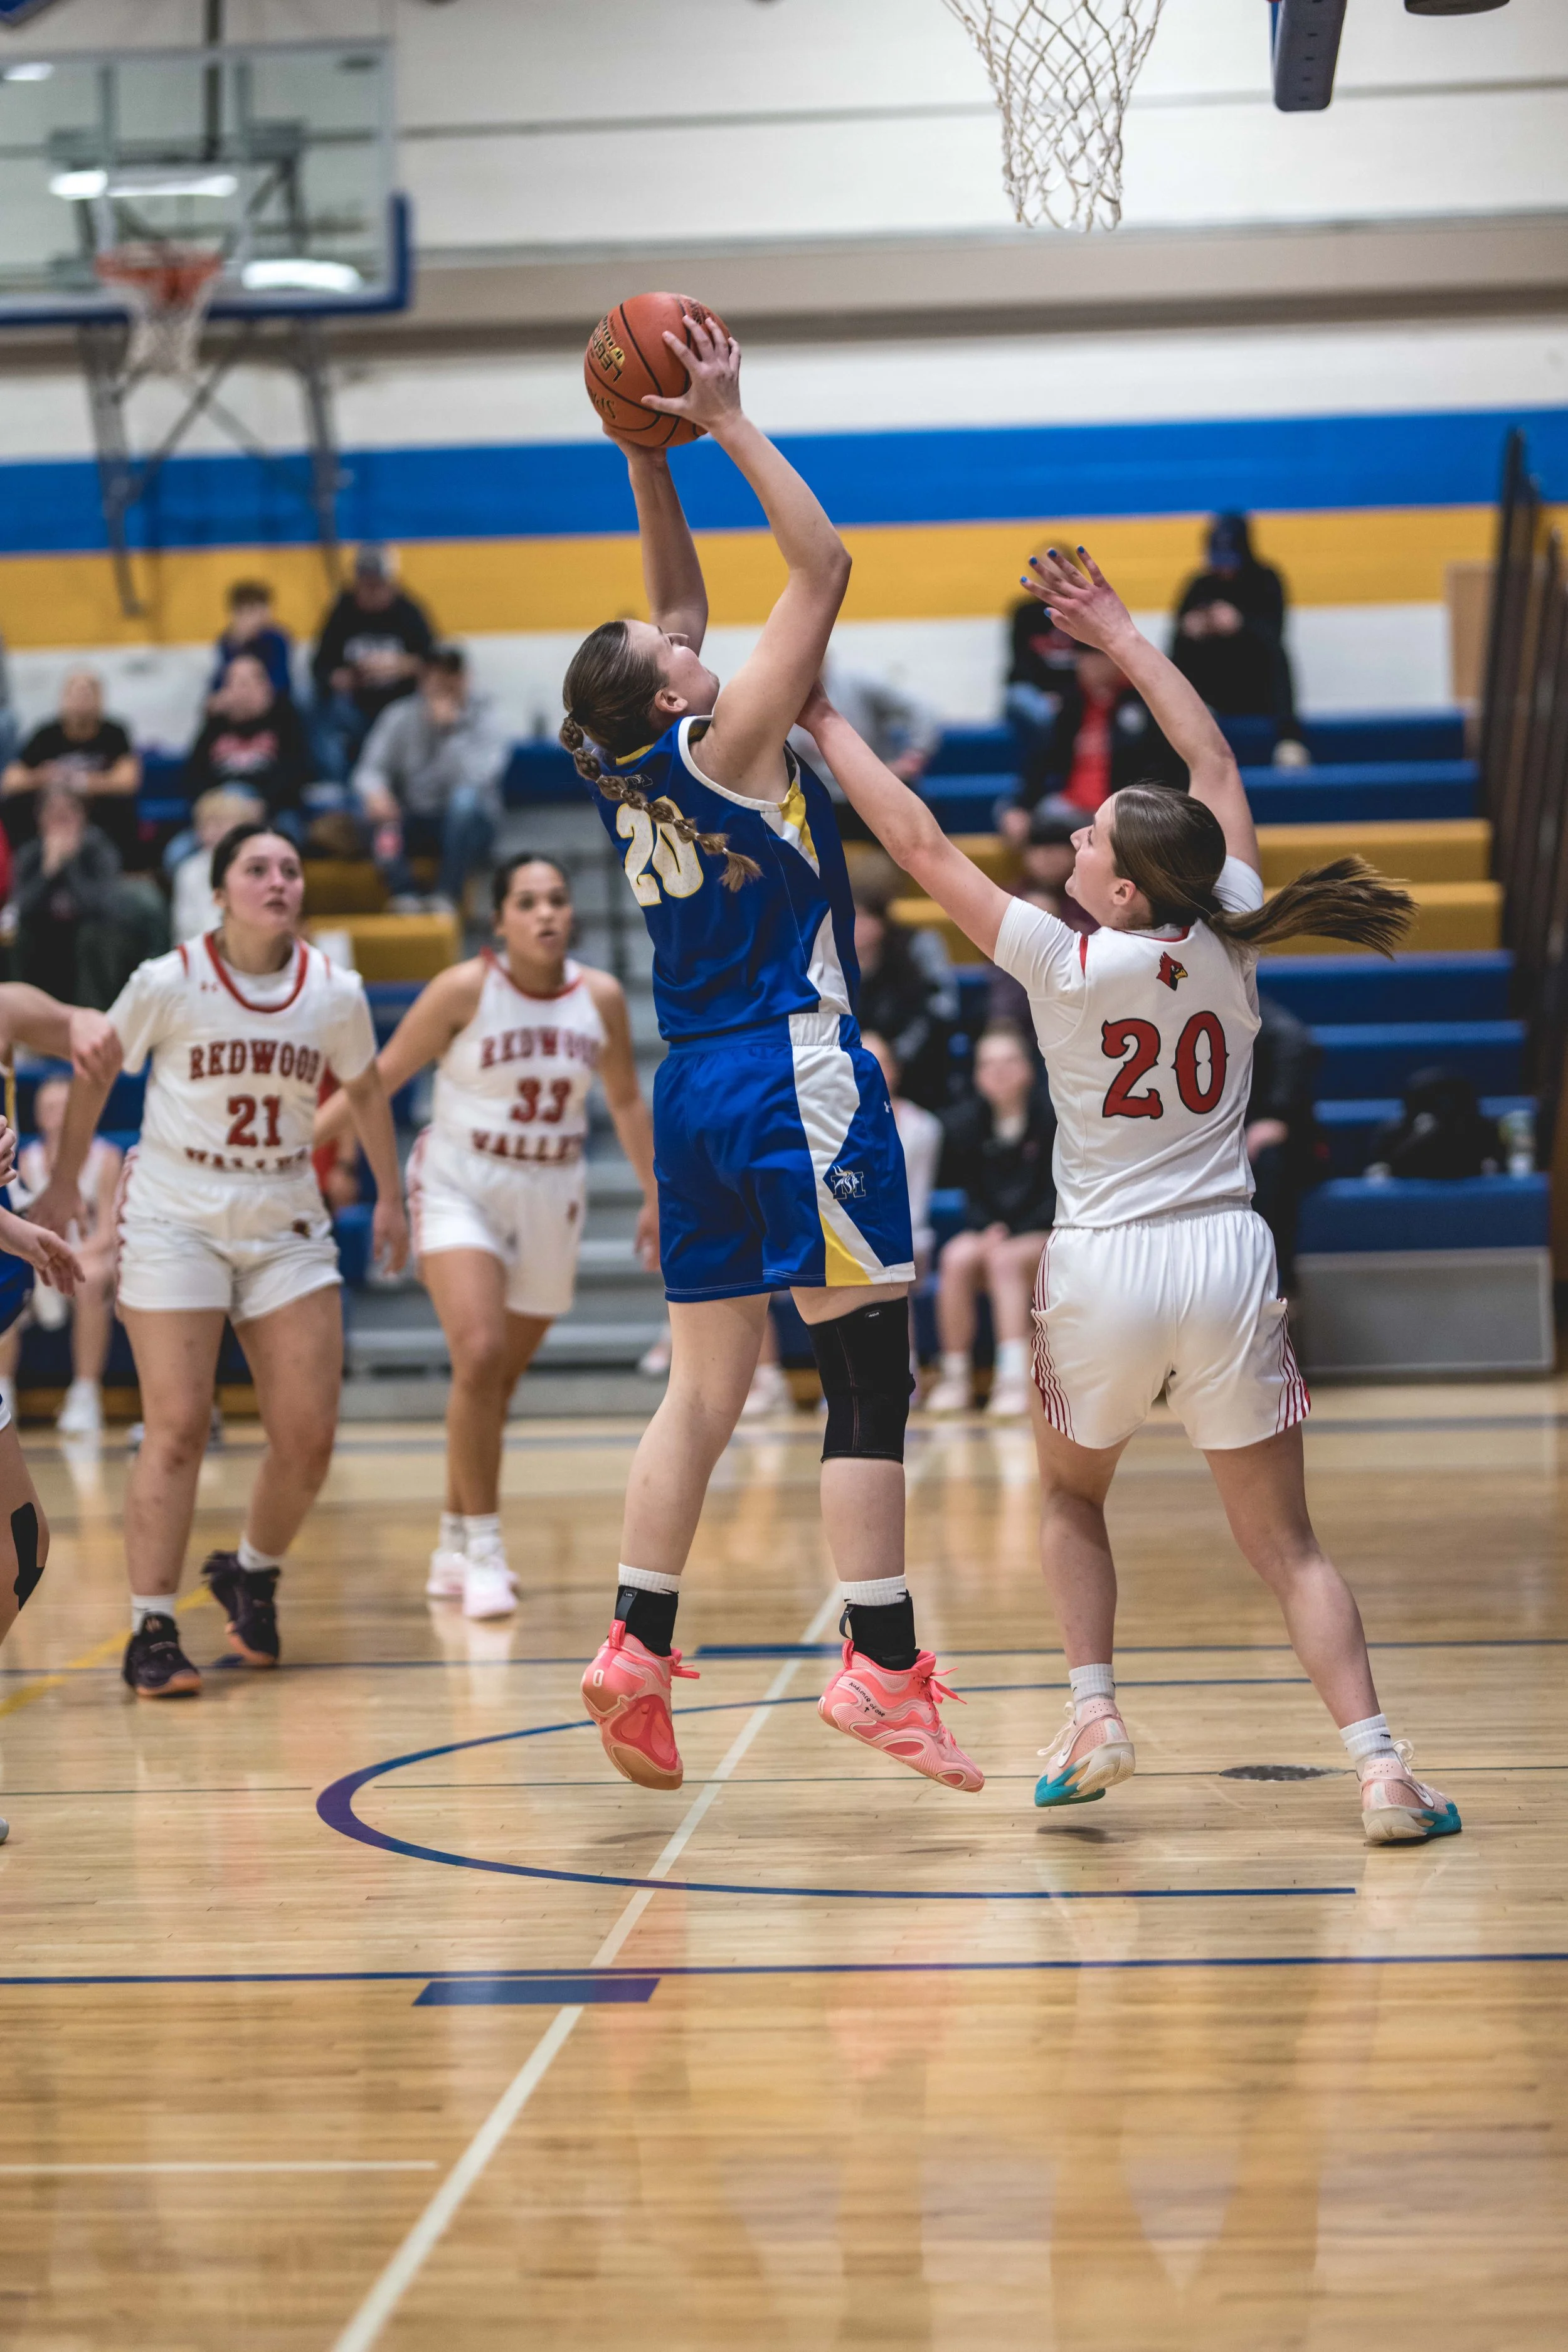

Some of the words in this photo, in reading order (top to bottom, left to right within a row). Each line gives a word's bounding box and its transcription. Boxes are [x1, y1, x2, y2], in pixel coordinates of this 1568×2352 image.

[616, 795, 704, 906] 20
[190, 1038, 319, 1084] REDWOOD
[1101, 1010, 1229, 1120] 20
[226, 1094, 282, 1147] 21
[510, 1076, 571, 1124] 33
[849, 1682, 871, 1702] Audience
[875, 1709, 886, 1717] one
